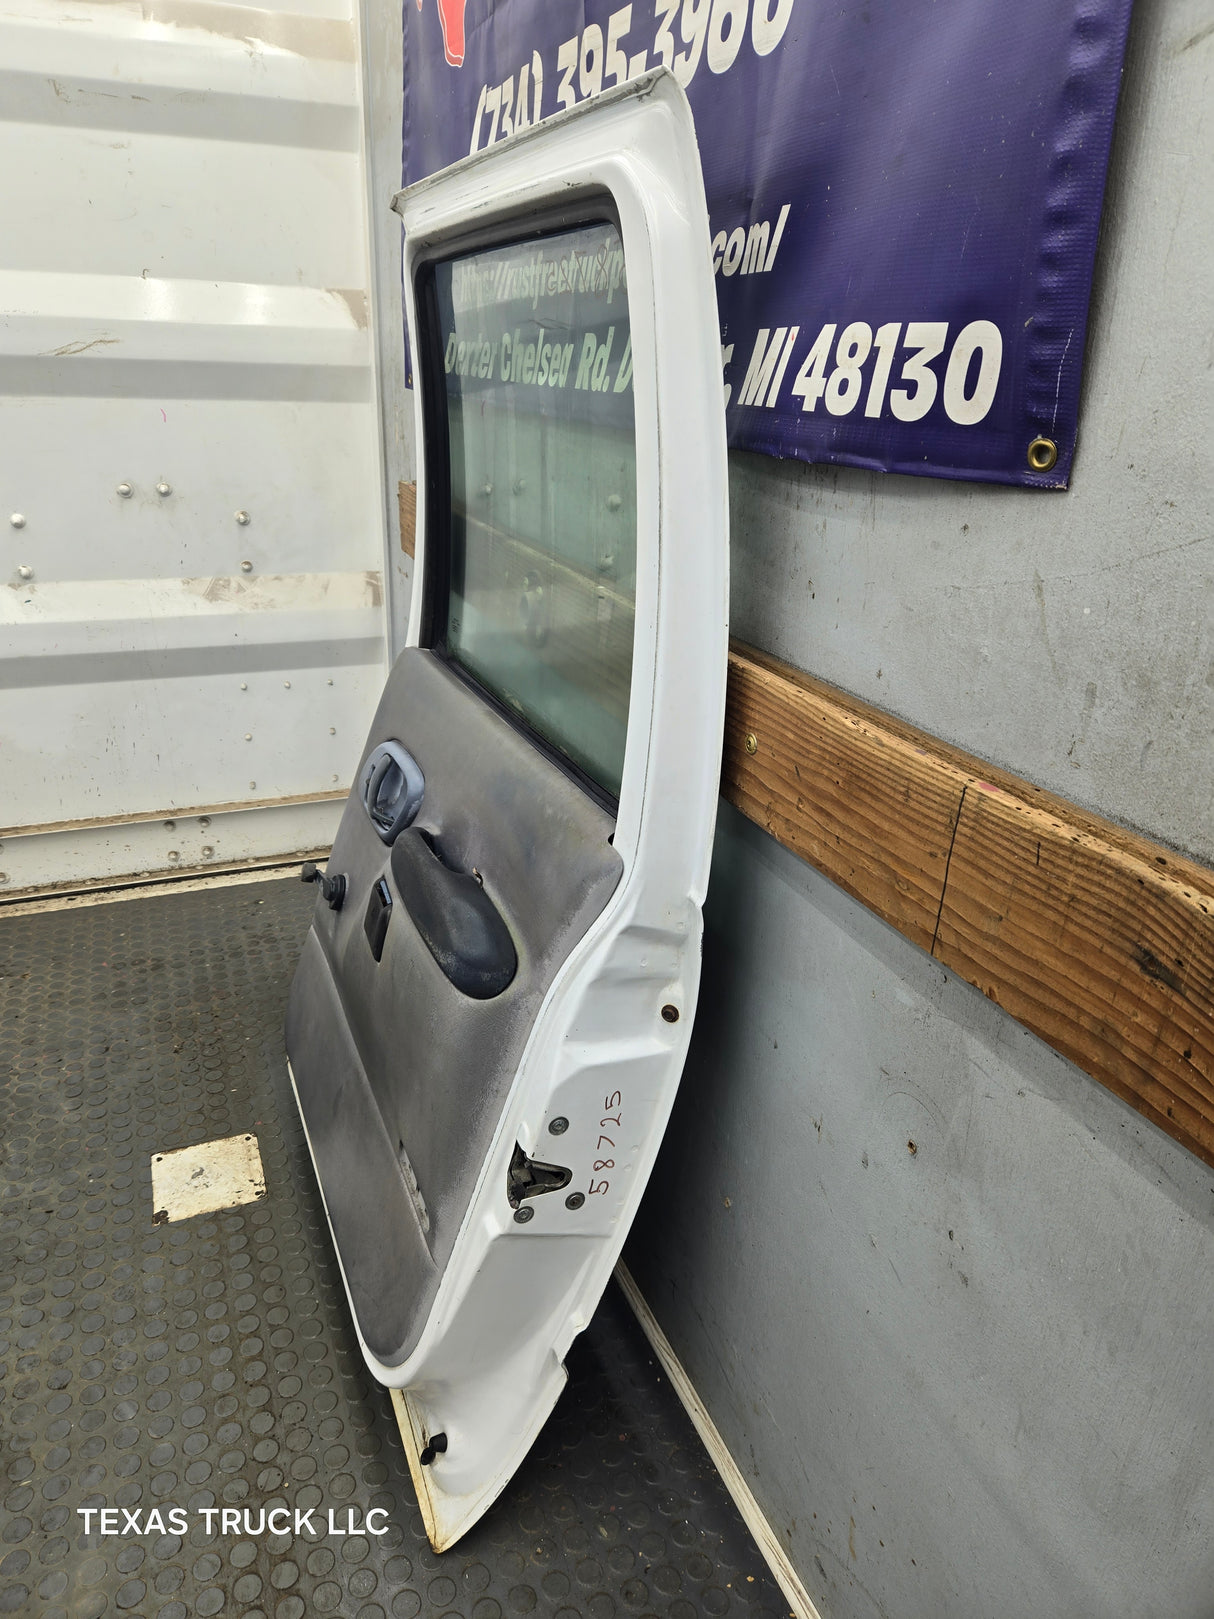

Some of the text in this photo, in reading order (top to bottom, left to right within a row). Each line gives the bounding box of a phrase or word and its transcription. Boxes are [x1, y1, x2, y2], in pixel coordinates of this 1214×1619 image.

[444, 333, 498, 379] Dexter
[501, 328, 574, 388] Chelsea
[575, 327, 615, 393] Rd.
[737, 326, 800, 409] MI
[791, 319, 1003, 426] 48130
[588, 1090, 622, 1195] 58725
